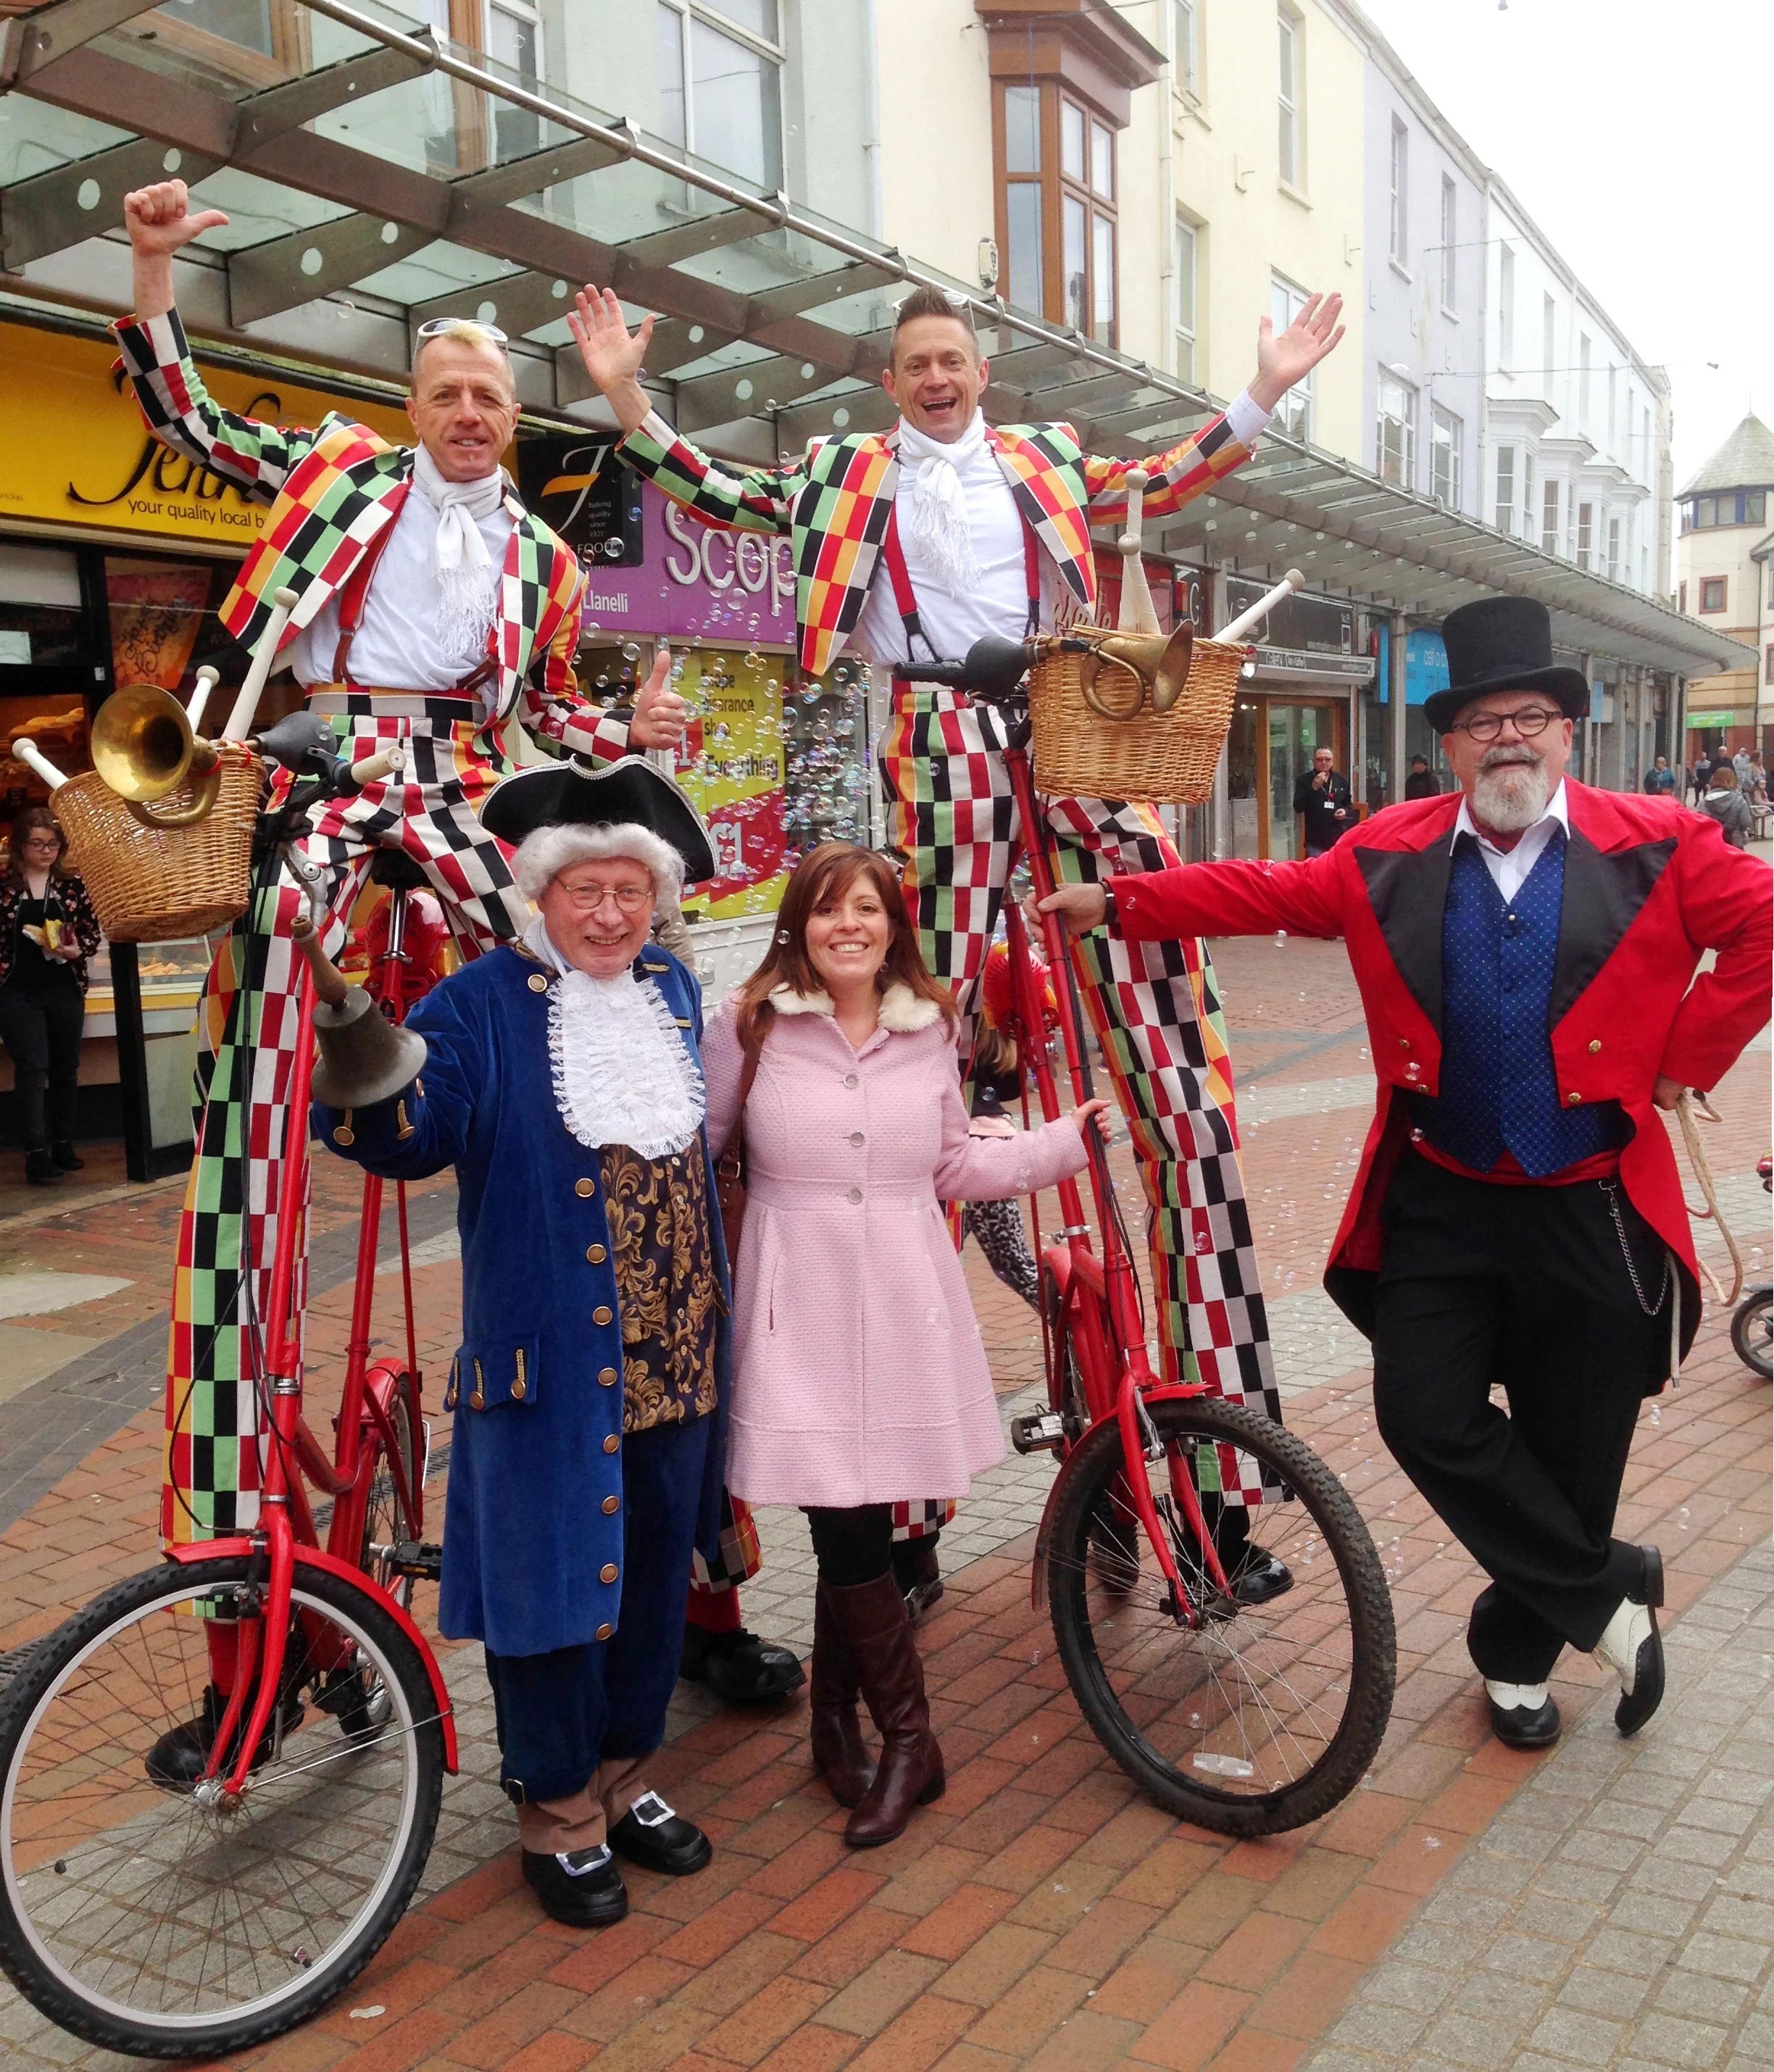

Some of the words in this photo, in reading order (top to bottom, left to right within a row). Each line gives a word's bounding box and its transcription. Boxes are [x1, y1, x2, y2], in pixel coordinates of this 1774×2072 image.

[128, 499, 164, 515] your
[167, 503, 216, 525] quality
[220, 508, 251, 527] local
[583, 589, 628, 613] Llanelli
